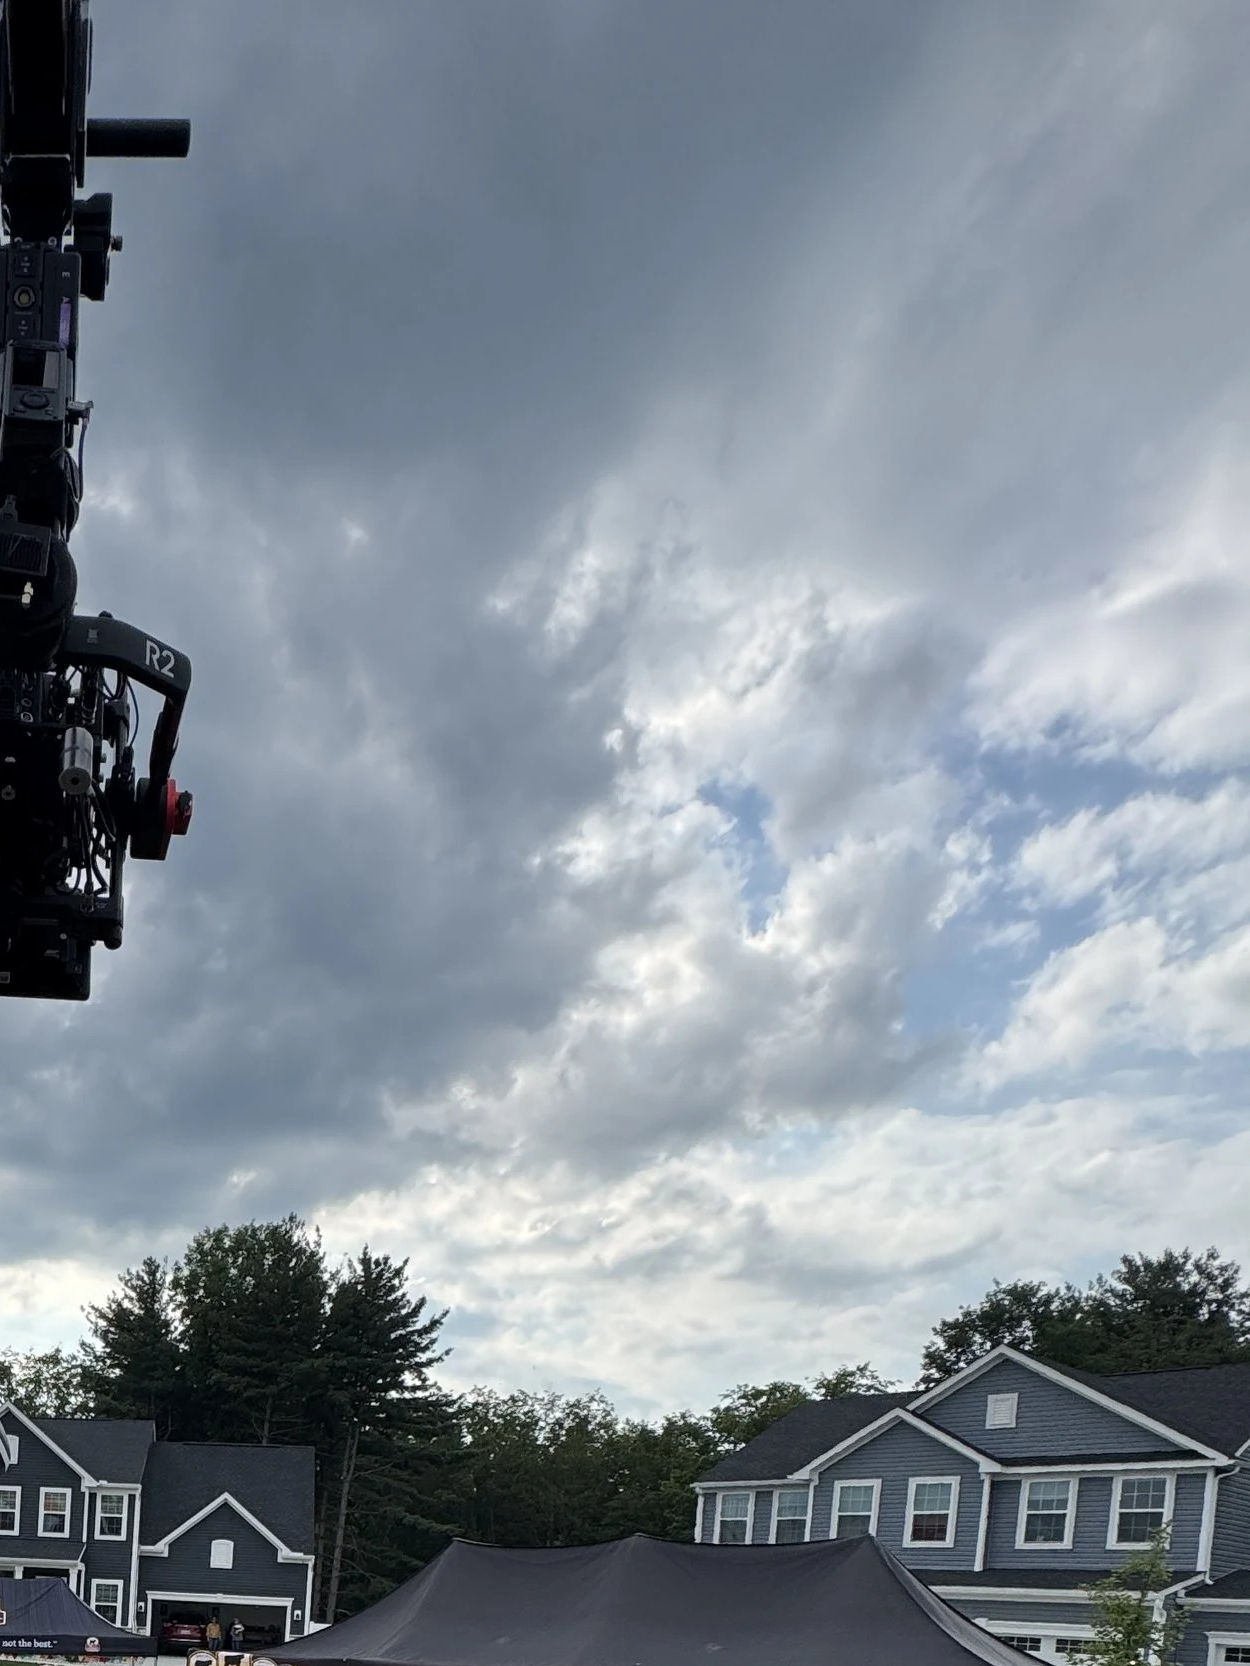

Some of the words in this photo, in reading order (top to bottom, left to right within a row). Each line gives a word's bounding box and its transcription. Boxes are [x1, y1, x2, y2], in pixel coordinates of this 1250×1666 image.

[145, 639, 175, 678] R2
[2, 1639, 17, 1648] not
[18, 1638, 32, 1648] the
